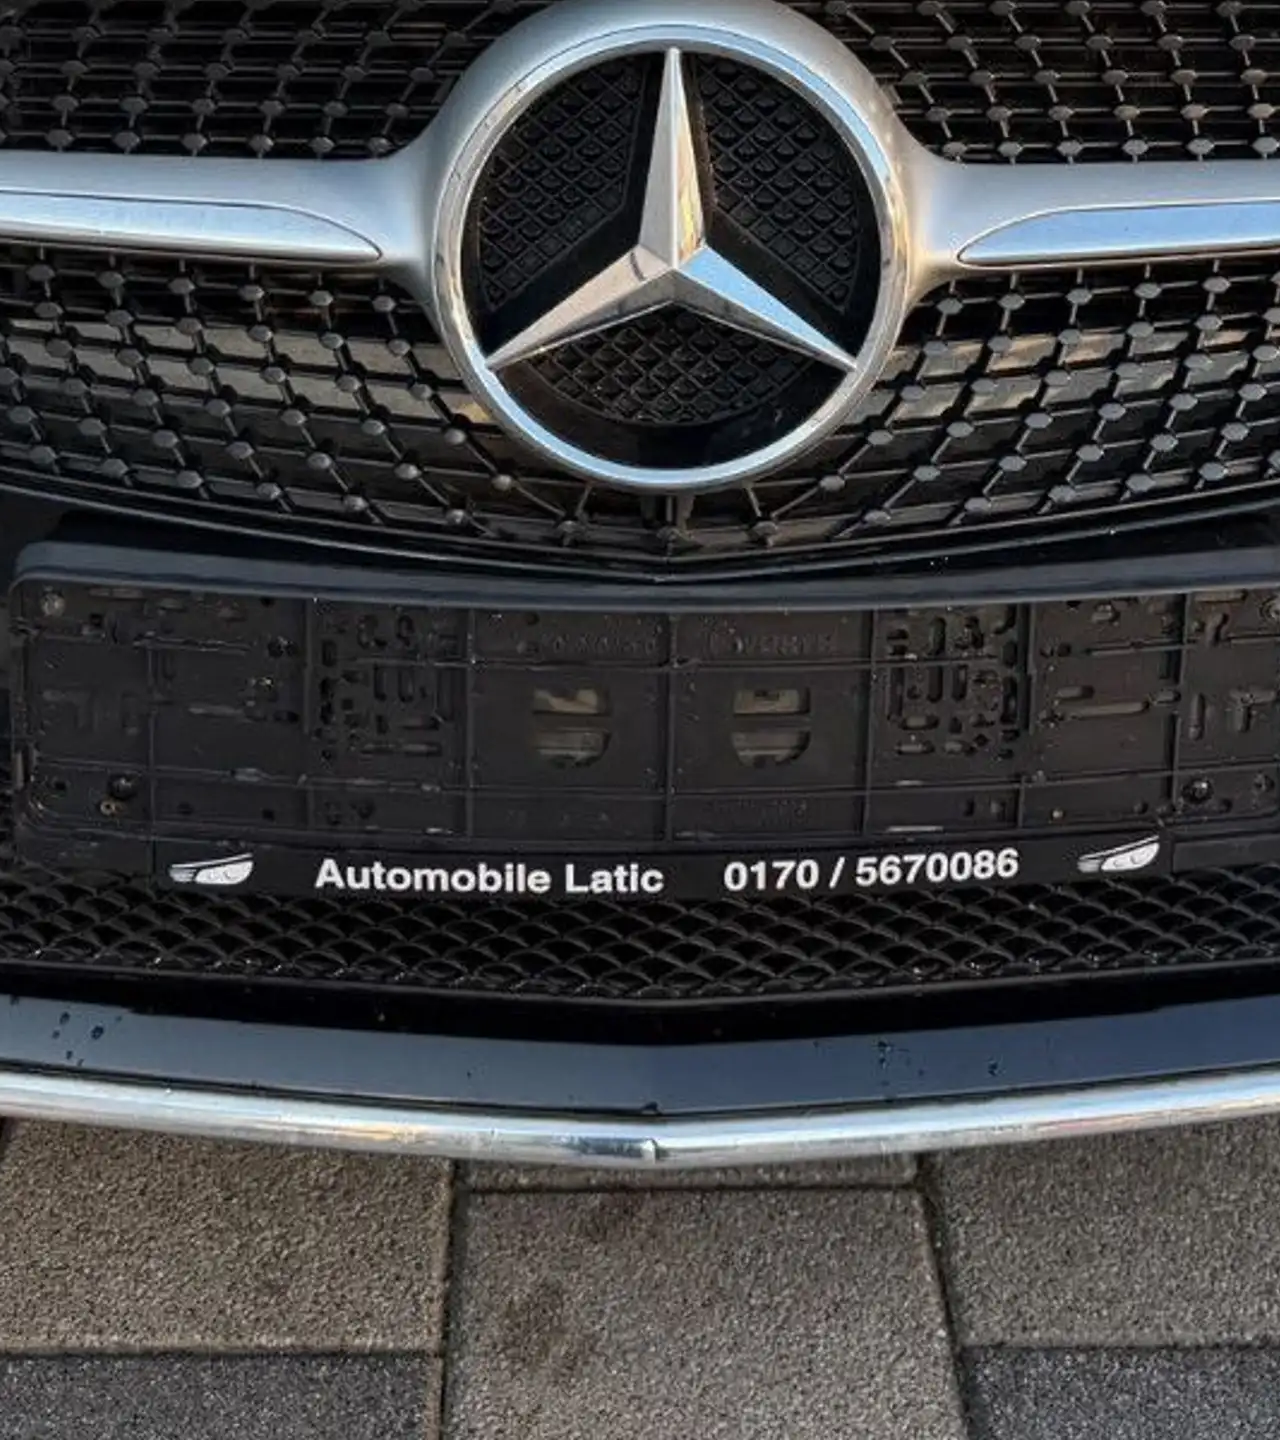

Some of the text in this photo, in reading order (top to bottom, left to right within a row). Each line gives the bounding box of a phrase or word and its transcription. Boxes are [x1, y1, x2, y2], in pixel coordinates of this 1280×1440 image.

[314, 858, 665, 894] Automobile Latic
[722, 846, 1020, 892] 0170 / 5670086
